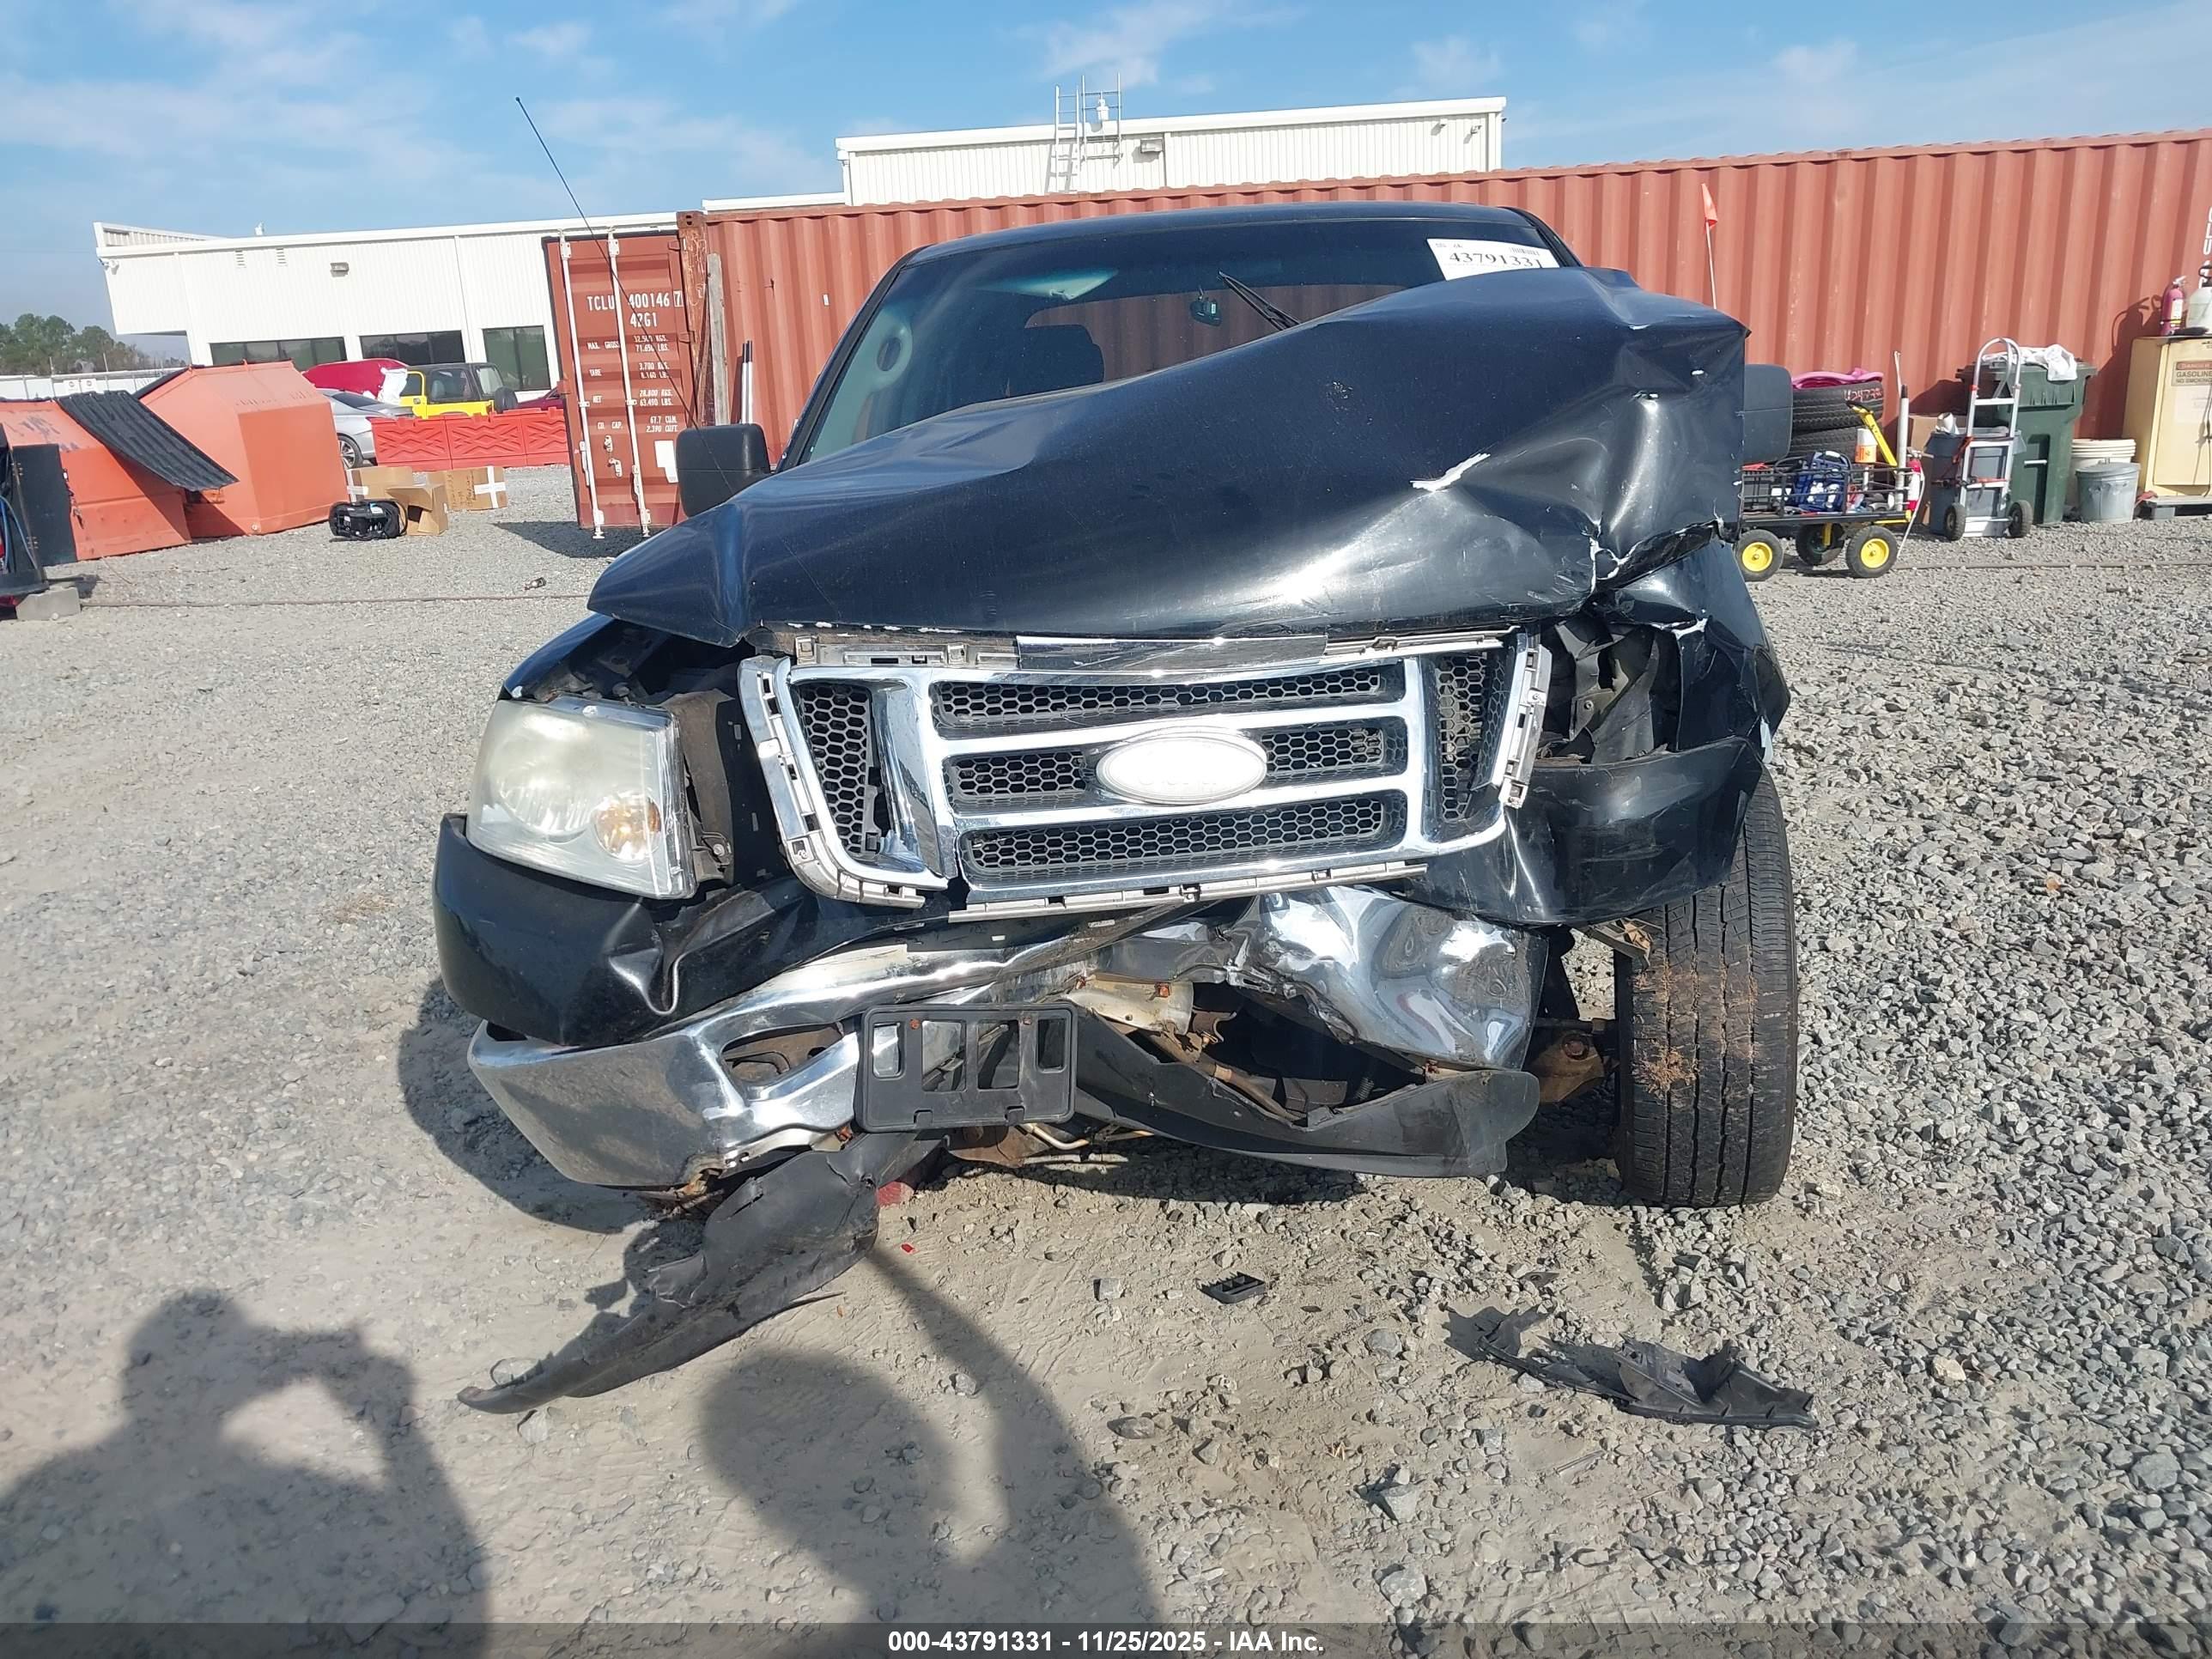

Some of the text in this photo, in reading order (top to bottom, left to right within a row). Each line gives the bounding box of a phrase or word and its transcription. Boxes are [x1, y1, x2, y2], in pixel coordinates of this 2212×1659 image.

[1449, 252, 1542, 268] 43791331
[586, 295, 615, 311] TCLU
[628, 292, 670, 308] 400146
[629, 312, 657, 328] 42G1
[586, 342, 600, 350] MAX.
[592, 395, 602, 404] NET
[660, 398, 673, 406] LBS.
